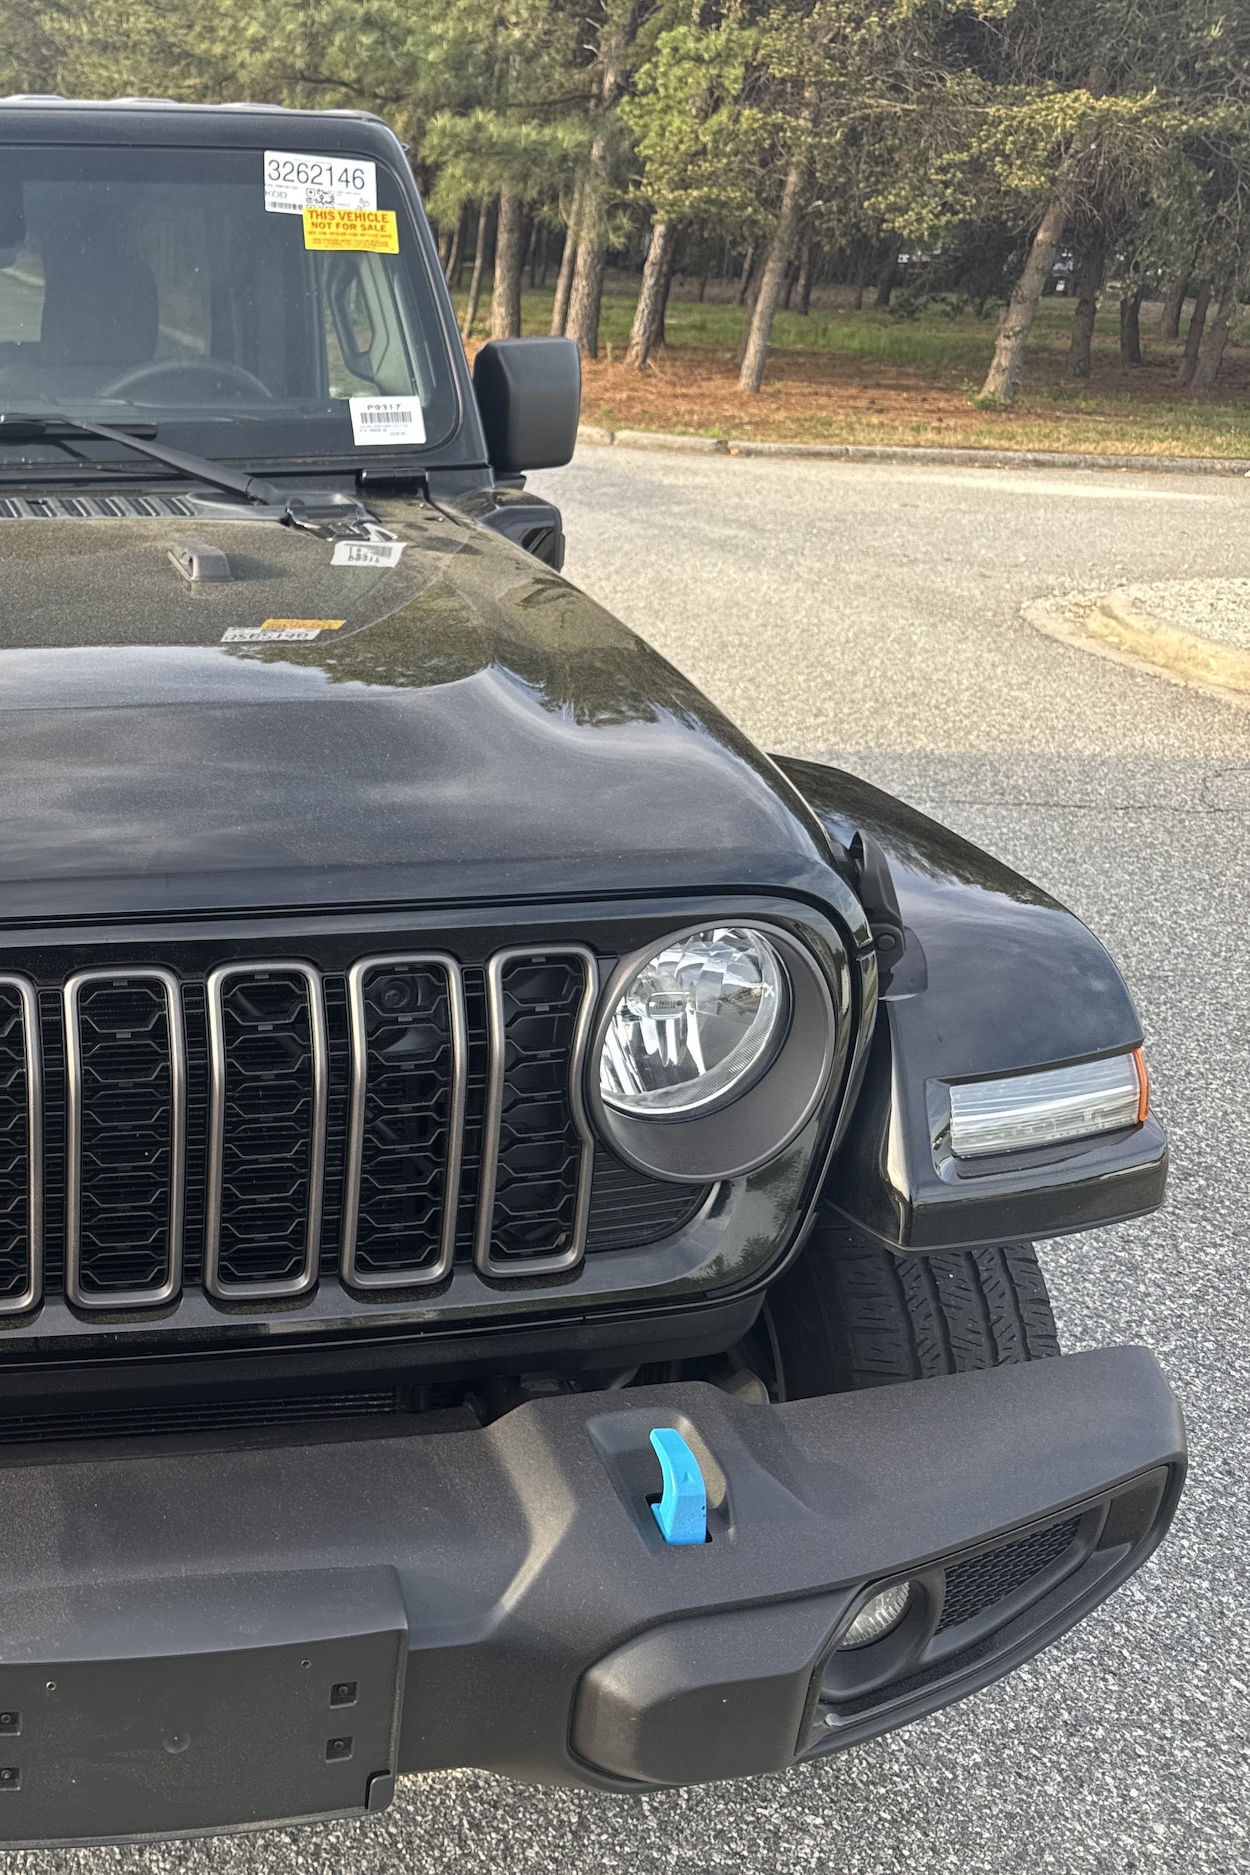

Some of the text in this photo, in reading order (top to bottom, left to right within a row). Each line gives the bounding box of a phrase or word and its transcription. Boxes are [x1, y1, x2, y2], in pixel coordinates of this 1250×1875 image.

[268, 159, 365, 190] 3262146
[307, 210, 389, 223] THIS VEHICLE
[311, 222, 387, 232] NOT FOR SALE
[367, 403, 401, 411] P9317
